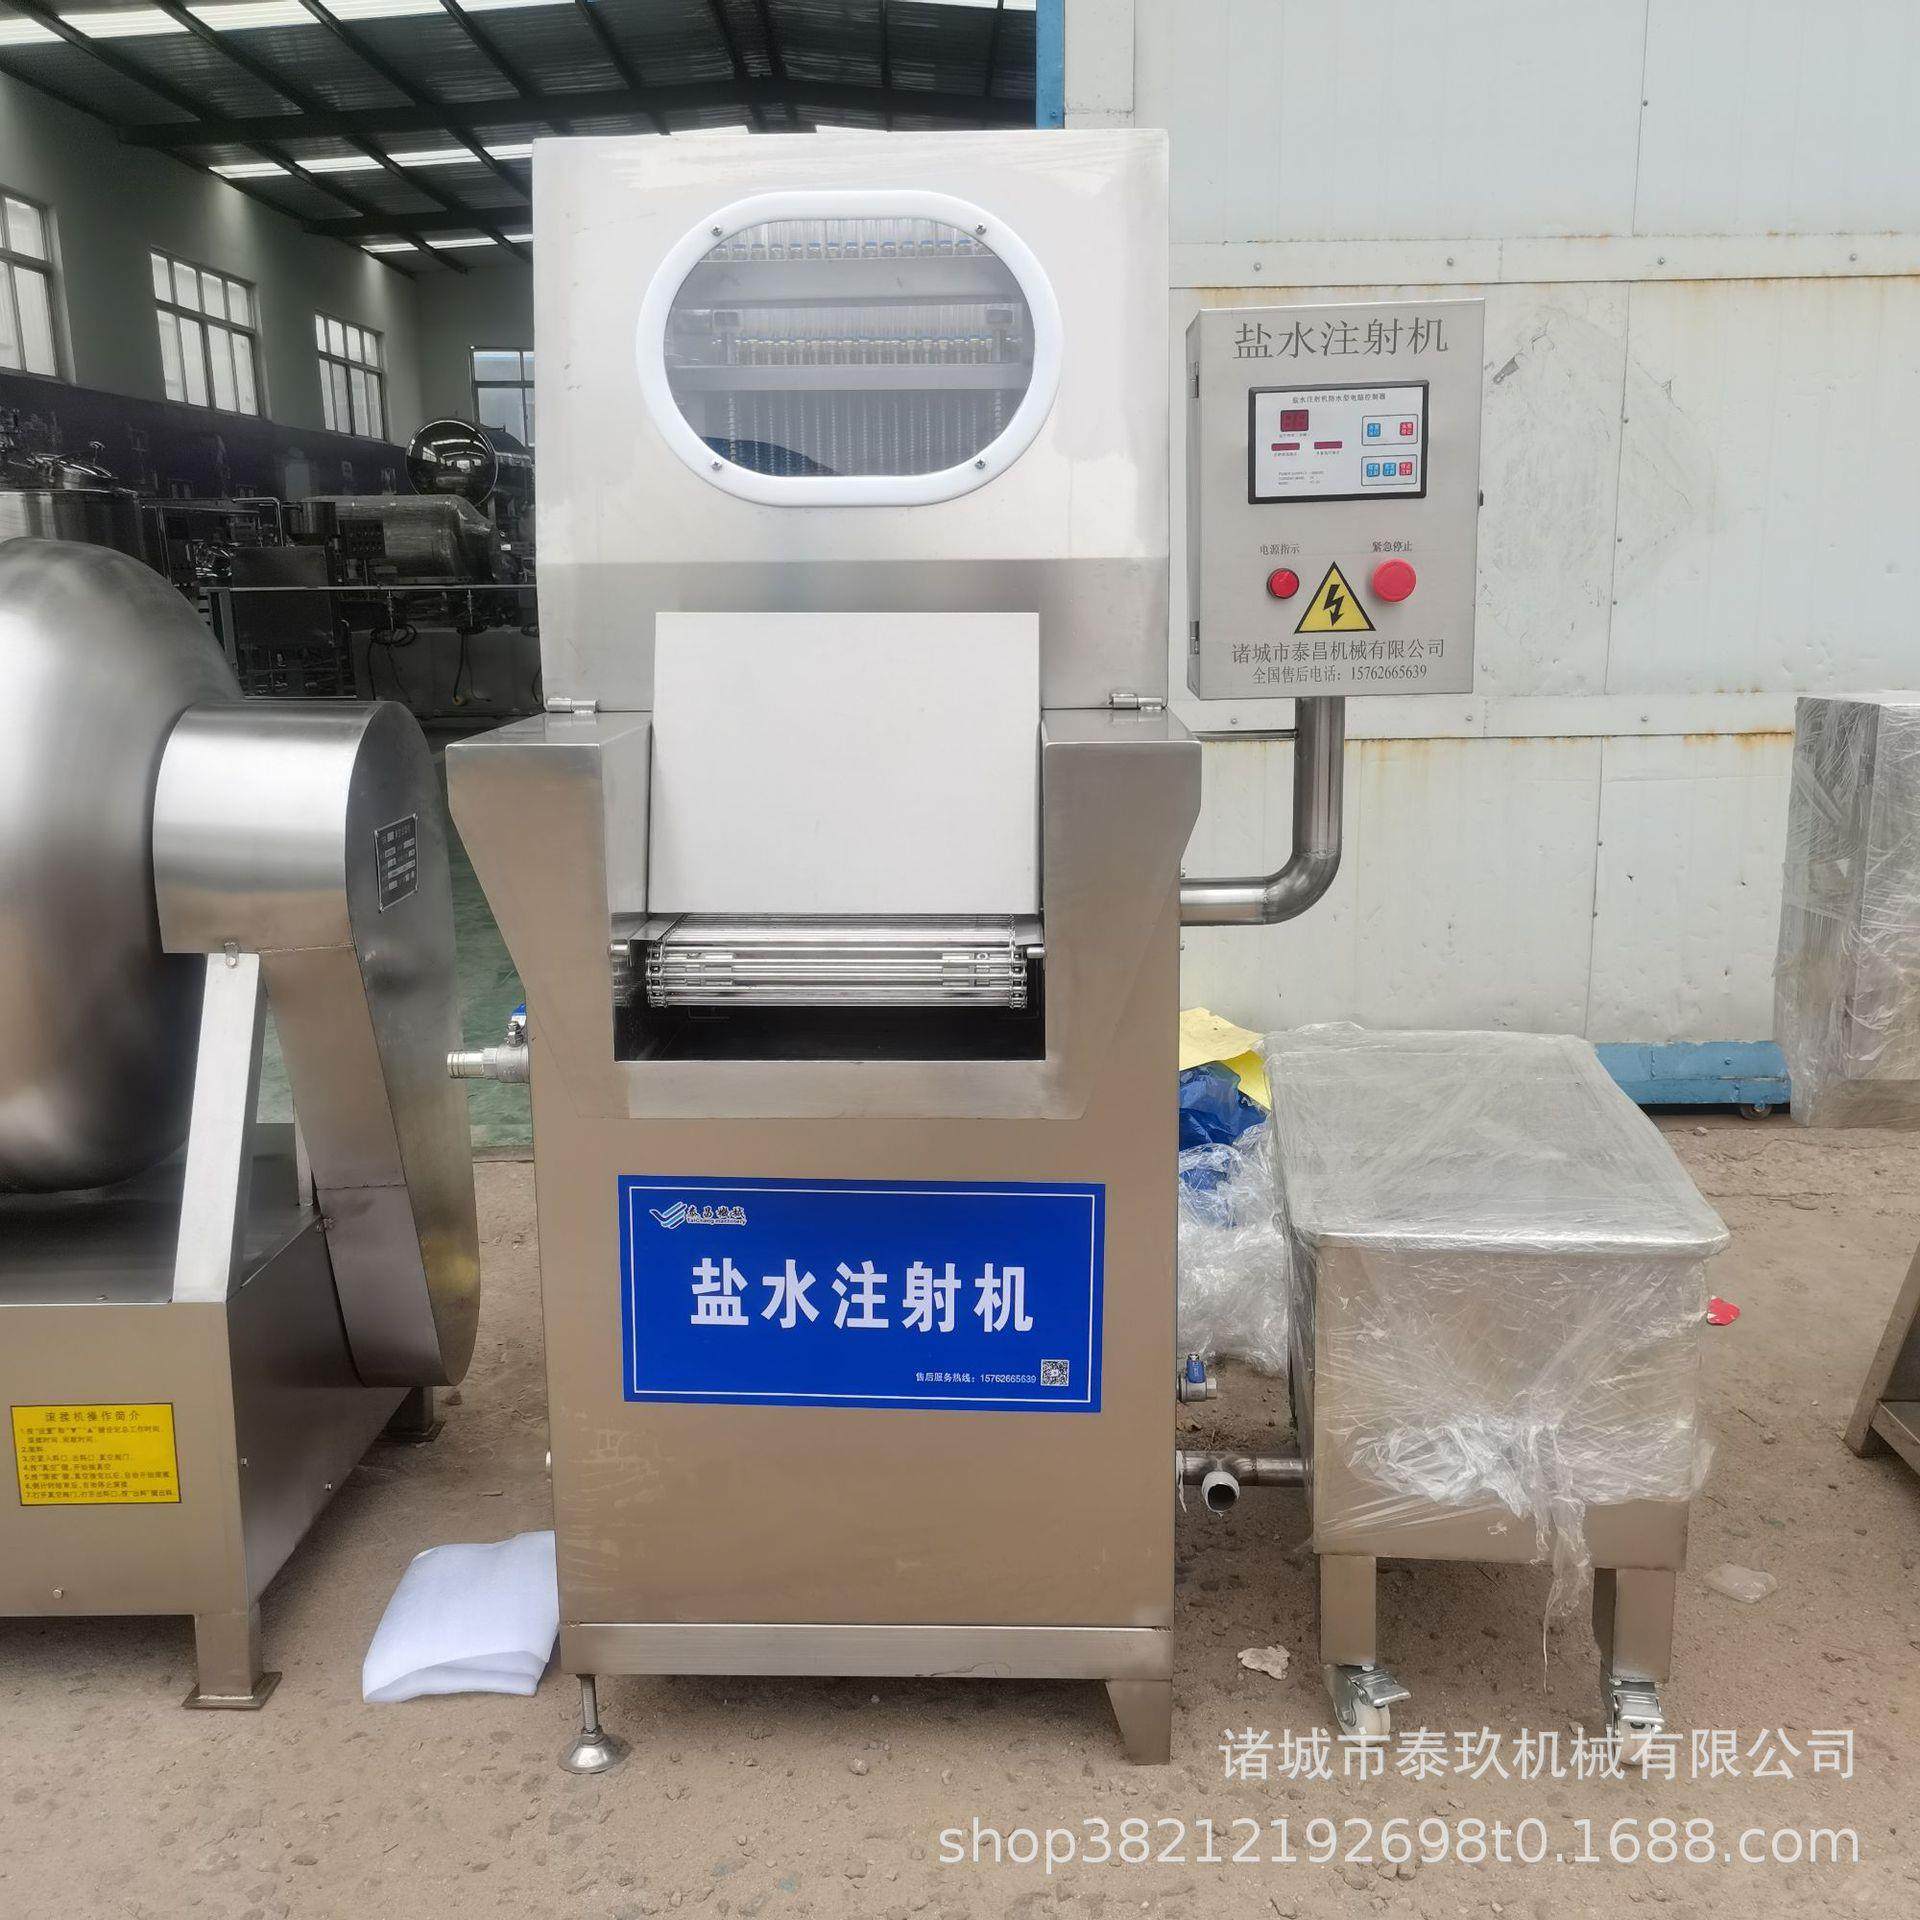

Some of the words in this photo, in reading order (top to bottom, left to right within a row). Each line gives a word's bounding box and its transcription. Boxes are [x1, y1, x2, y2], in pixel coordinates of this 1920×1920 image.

[1232, 317, 1449, 359] 盐水注射机
[1259, 544, 1301, 556] 电源指示
[1371, 541, 1413, 552] 紧急停止
[1231, 638, 1445, 664] 诸城市泰昌机械有限公司
[690, 1257, 1034, 1333] 盐水注射机
